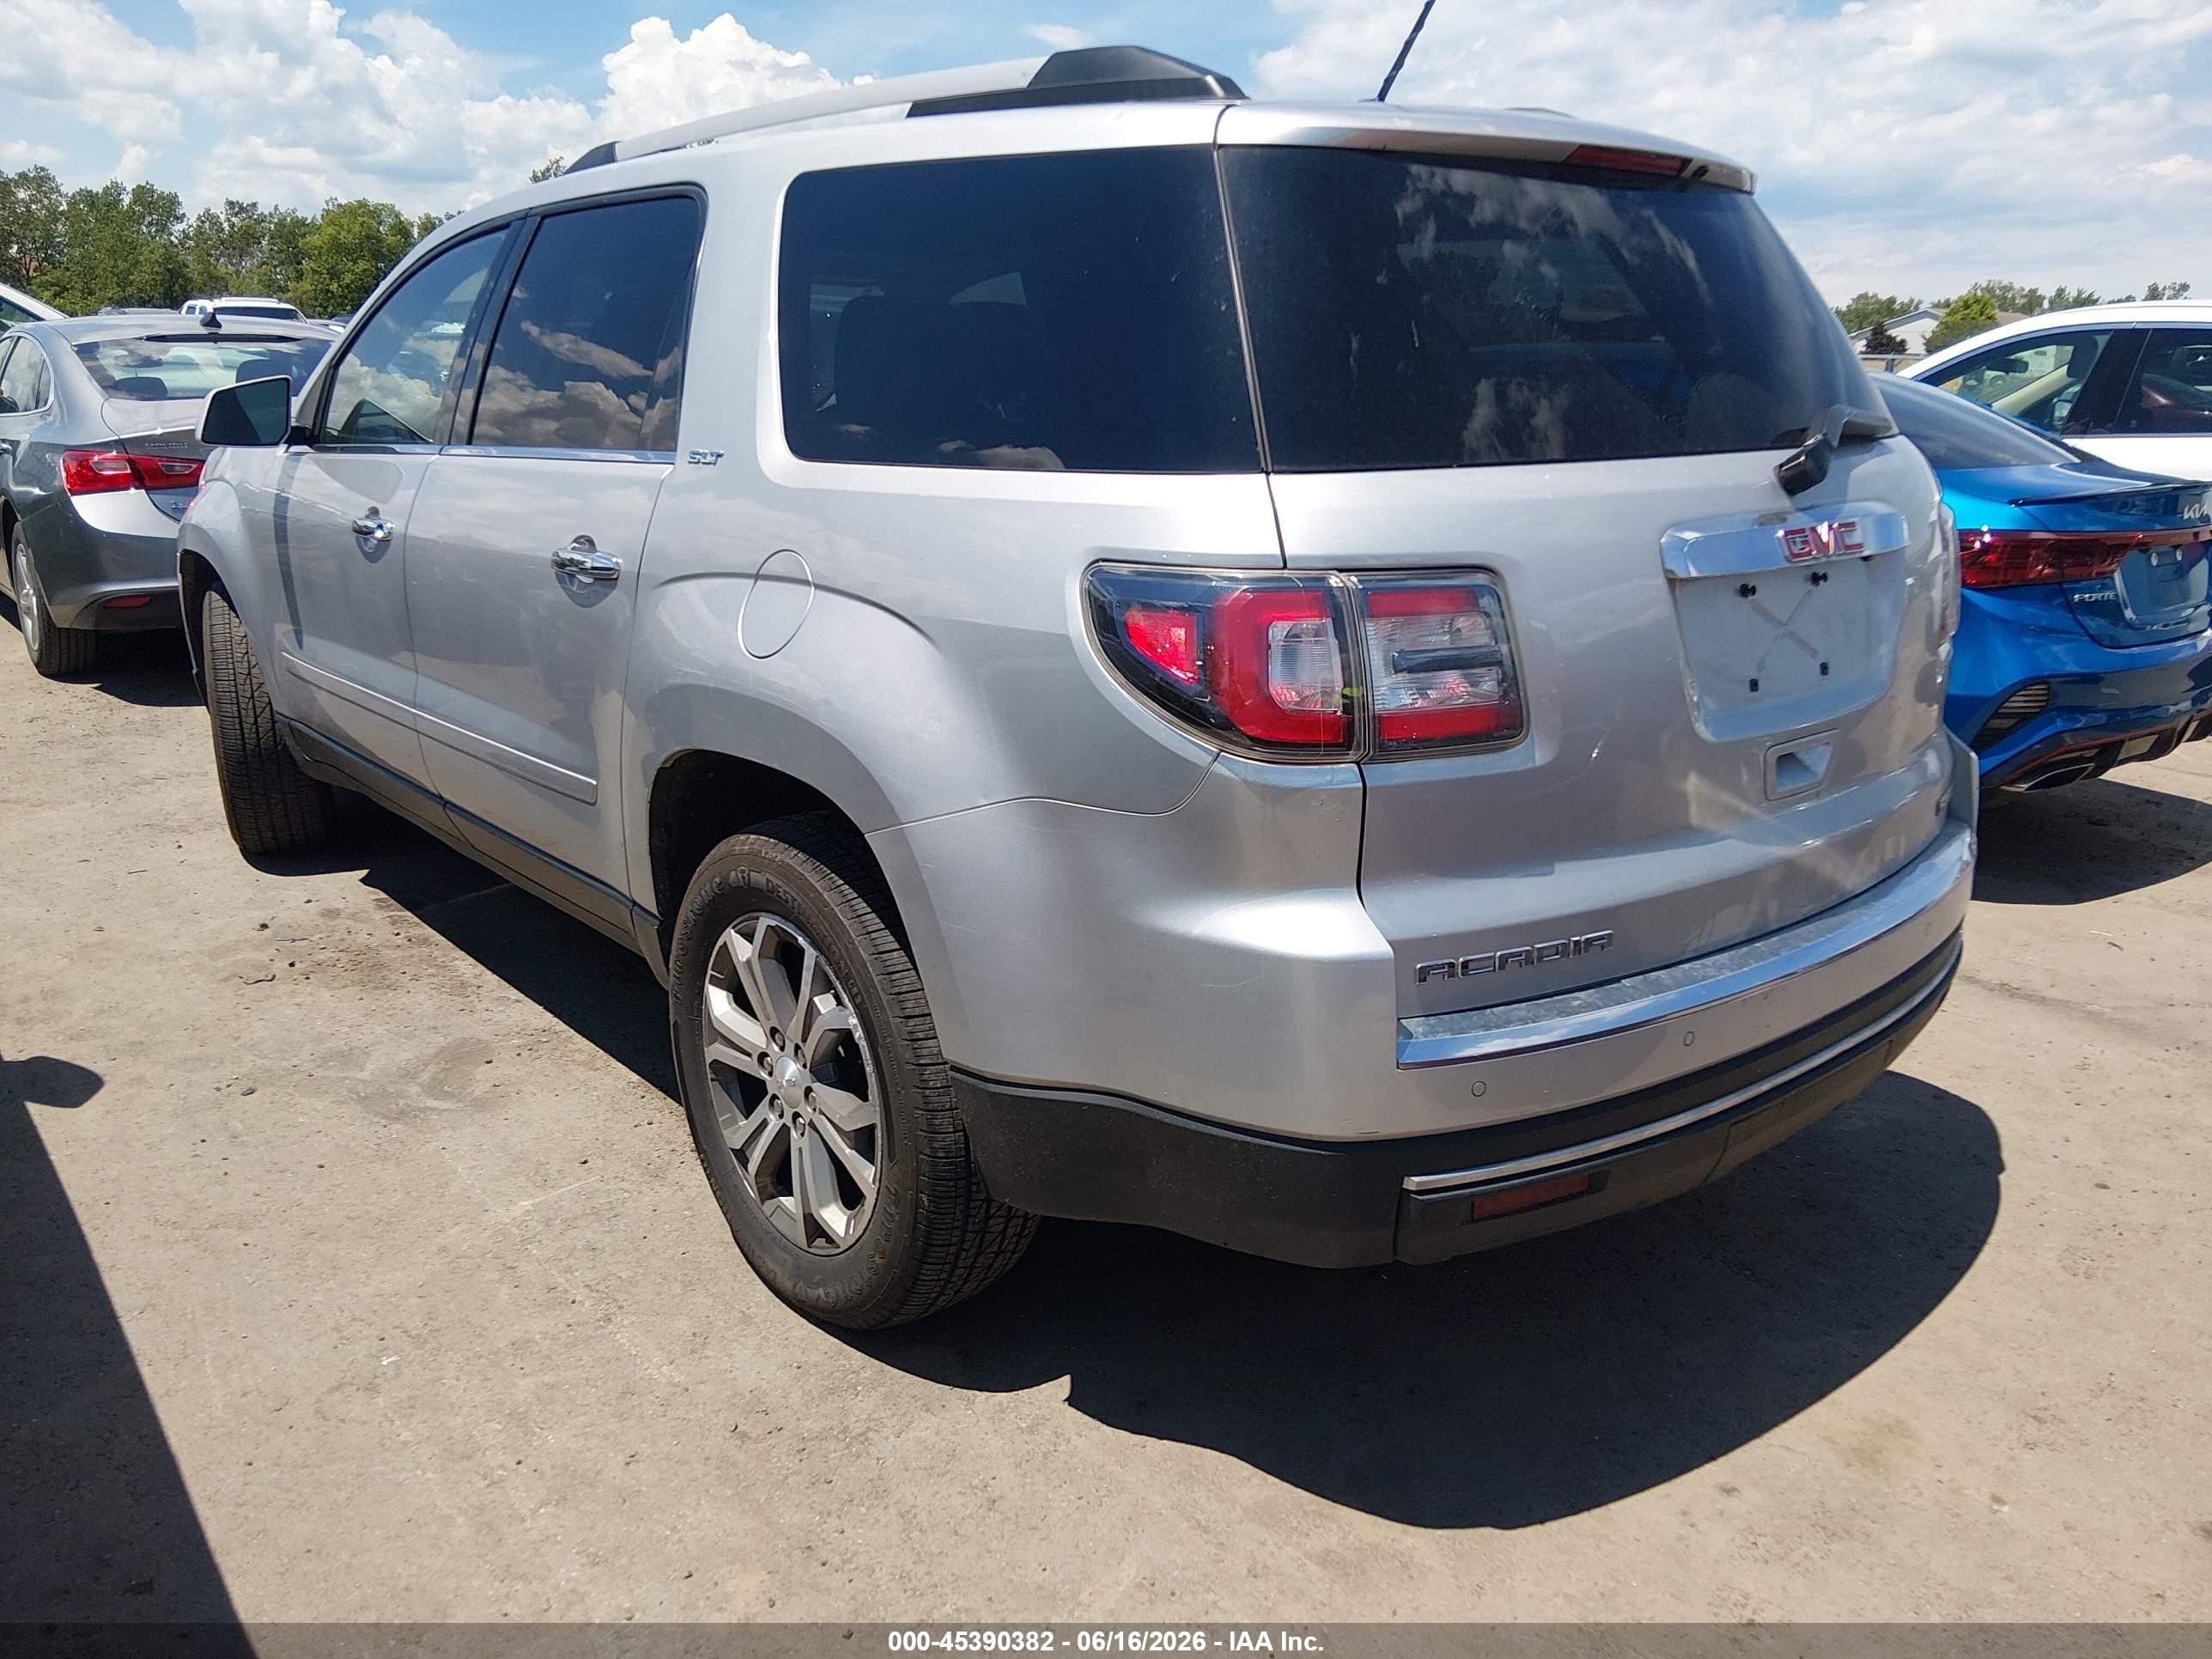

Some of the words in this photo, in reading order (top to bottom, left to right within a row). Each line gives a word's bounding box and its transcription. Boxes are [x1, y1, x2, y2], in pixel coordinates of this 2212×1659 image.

[687, 449, 725, 466] SLT
[1775, 520, 1865, 562] GMC
[2073, 592, 2118, 602] FORTE
[1415, 929, 1614, 986] ACADIA
